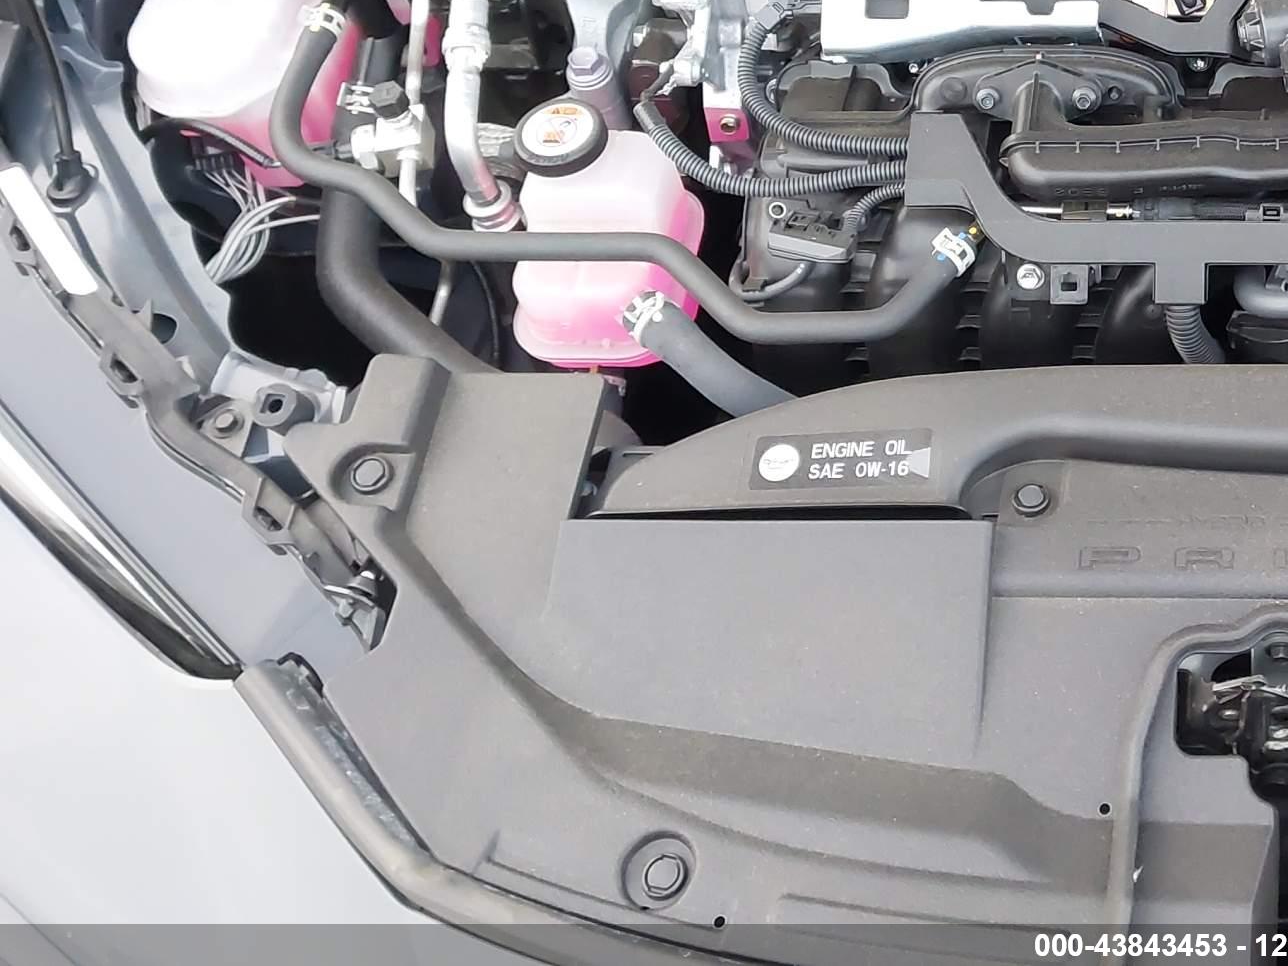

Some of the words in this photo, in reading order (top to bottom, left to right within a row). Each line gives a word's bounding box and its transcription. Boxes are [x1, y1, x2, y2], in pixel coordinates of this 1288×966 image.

[811, 441, 875, 459] ENGINE
[885, 439, 912, 455] OIL
[808, 462, 846, 479] SAE
[855, 460, 910, 478] 0W-16
